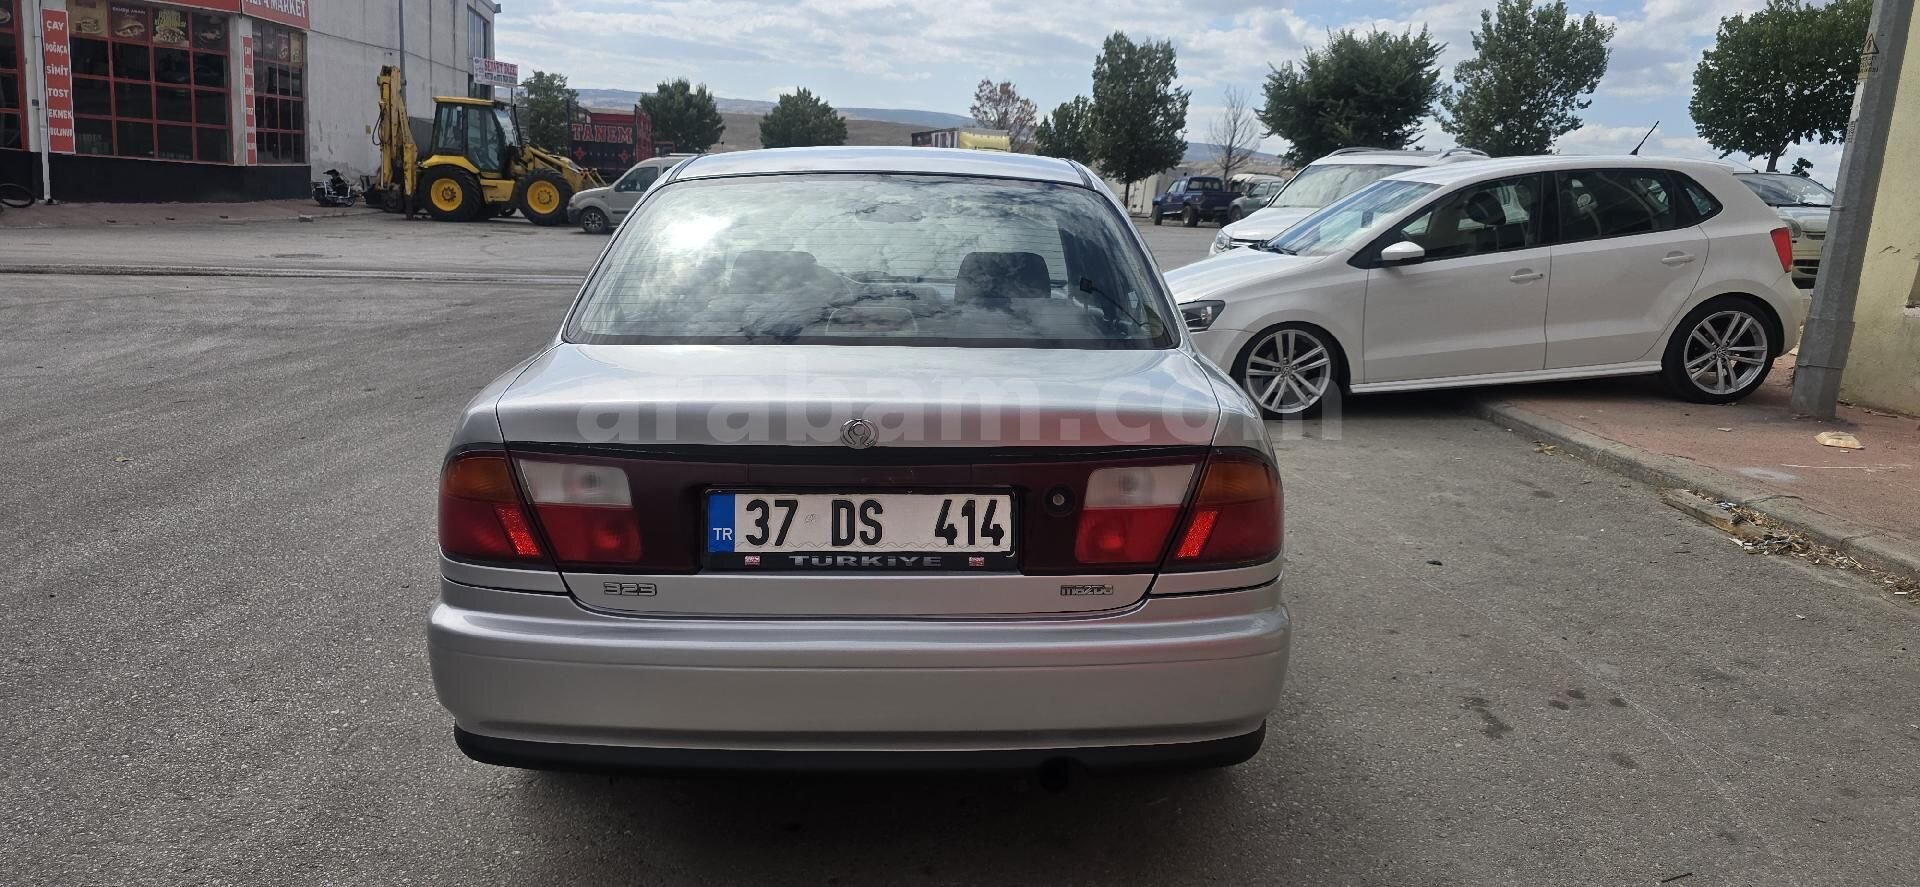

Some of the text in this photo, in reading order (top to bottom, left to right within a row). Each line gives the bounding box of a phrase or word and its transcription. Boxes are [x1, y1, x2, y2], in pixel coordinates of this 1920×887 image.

[47, 20, 65, 32] ÇAY
[46, 63, 69, 76] SİMİT
[47, 87, 69, 98] TOST
[48, 108, 73, 119] EKMEK
[571, 123, 633, 145] TANEM
[745, 499, 1005, 547] 37 DS 414
[713, 527, 733, 541] TR
[603, 582, 657, 596] 323
